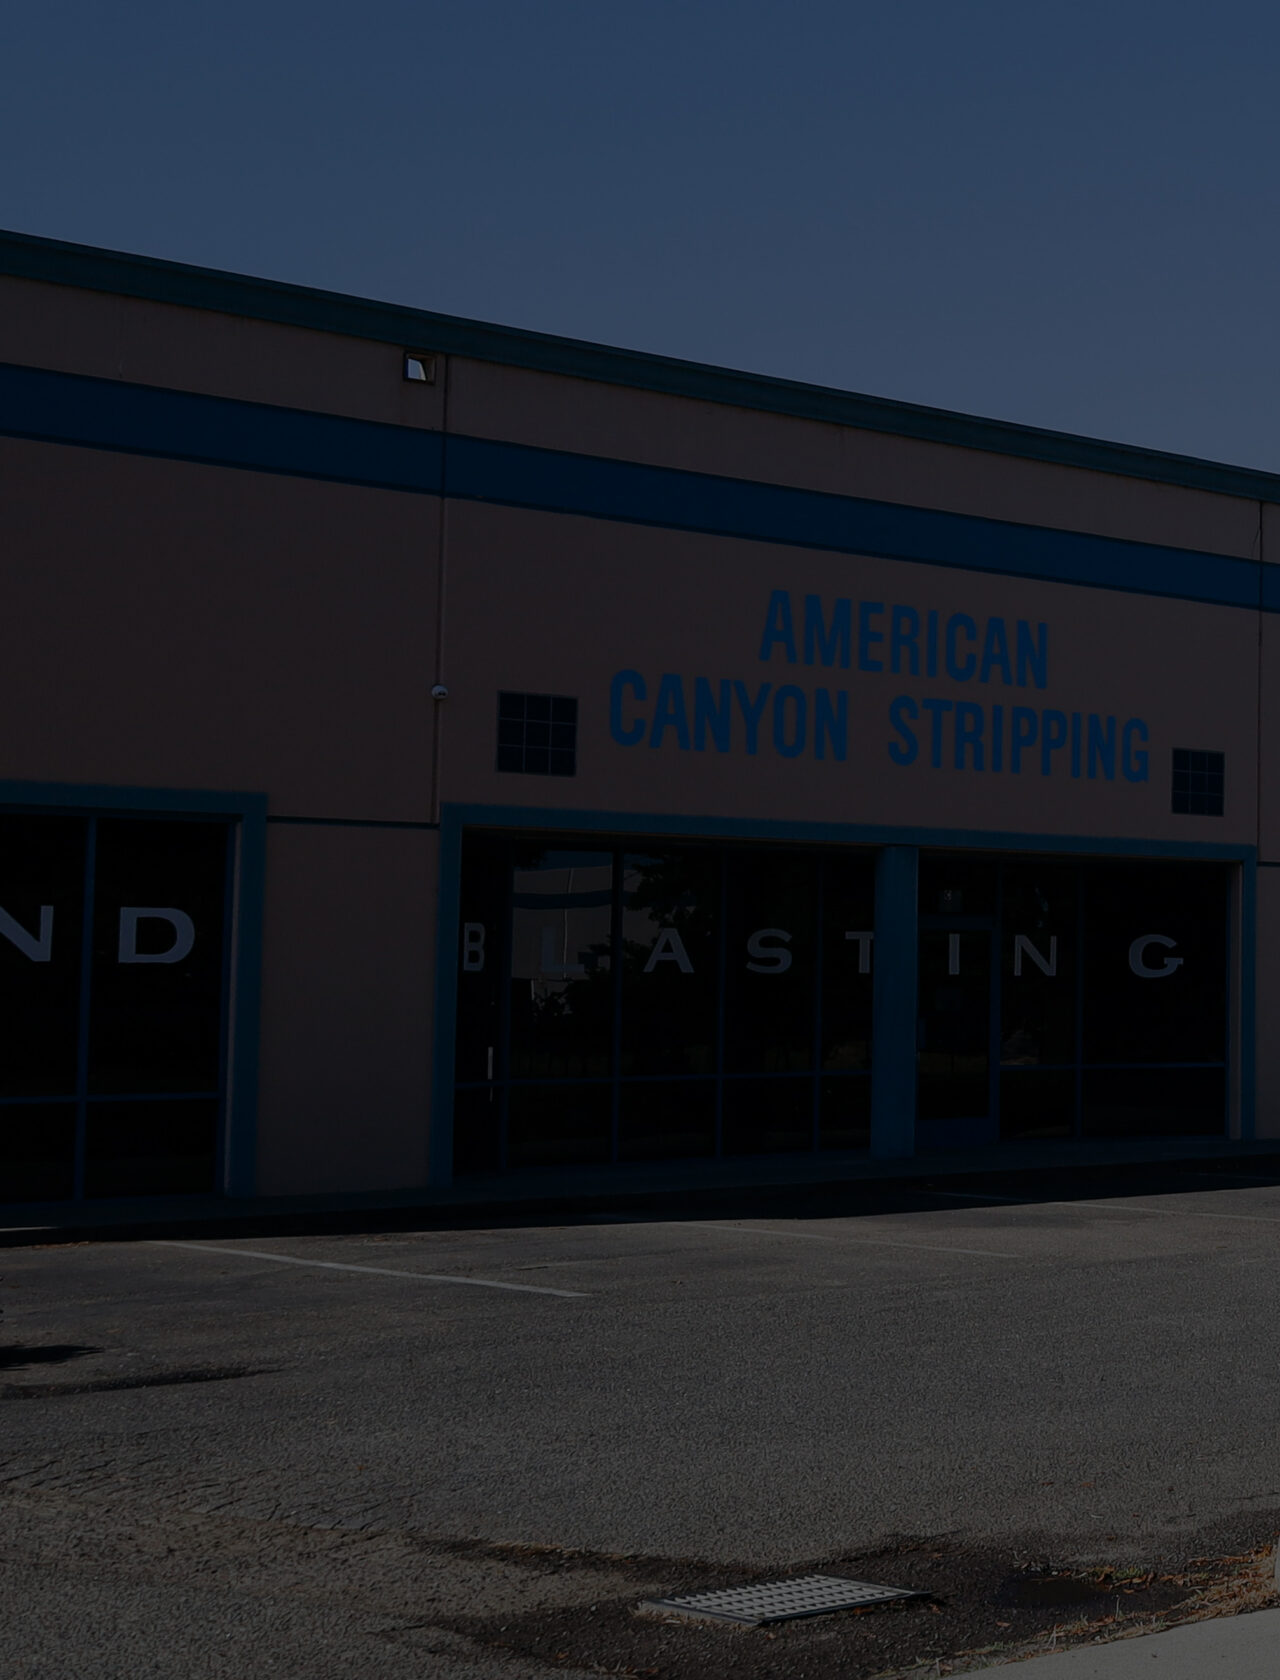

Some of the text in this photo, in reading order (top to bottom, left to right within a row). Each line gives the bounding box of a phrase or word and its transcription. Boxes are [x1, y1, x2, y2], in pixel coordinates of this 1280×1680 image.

[759, 589, 1048, 690] AMERICAN
[609, 669, 1149, 783] CANYON STRIPPING
